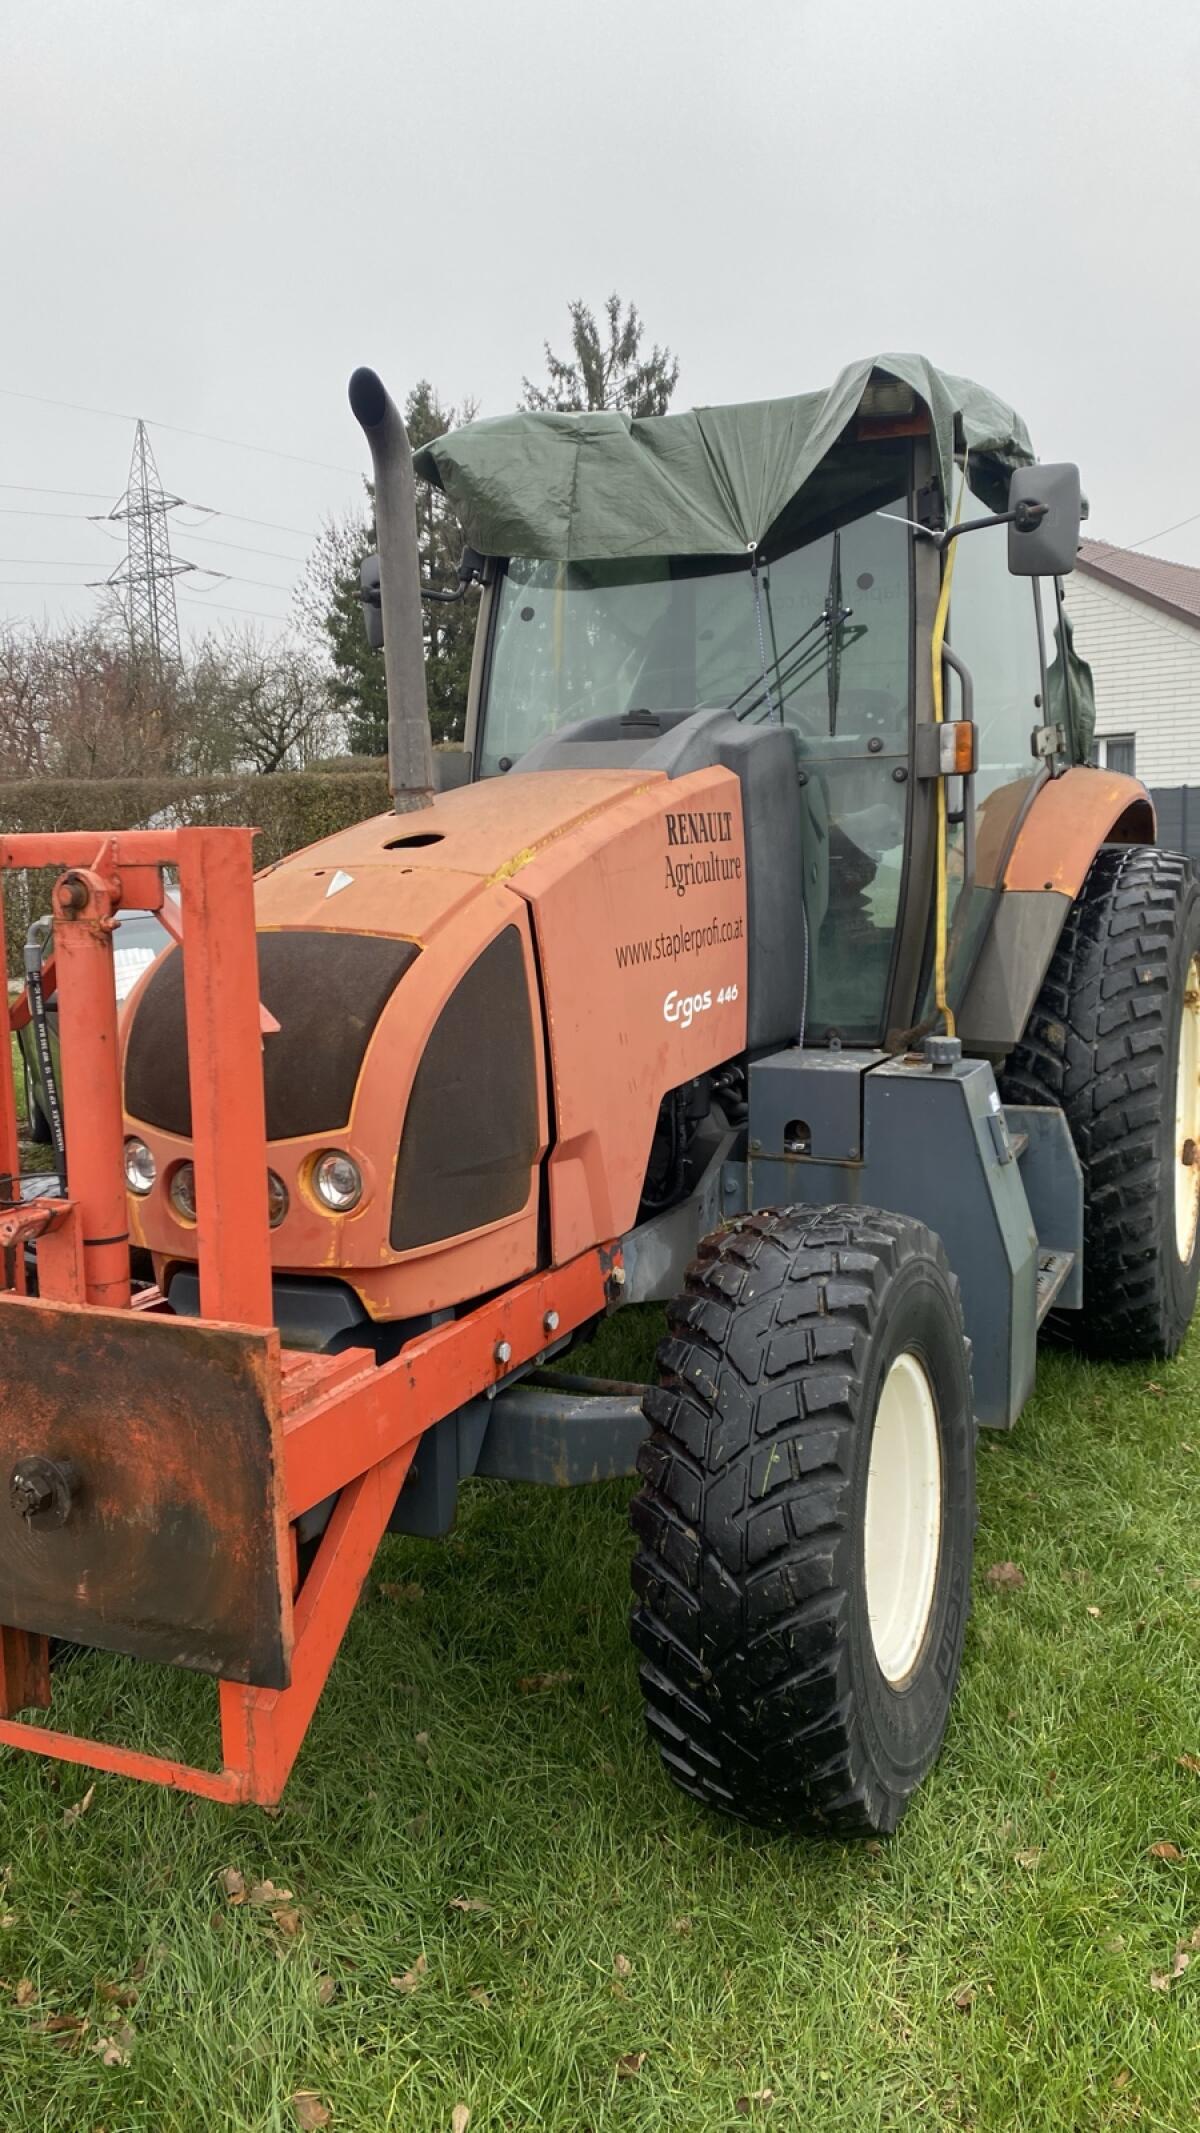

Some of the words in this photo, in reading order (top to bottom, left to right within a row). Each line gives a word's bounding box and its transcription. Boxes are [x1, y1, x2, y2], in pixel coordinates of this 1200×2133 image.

[665, 812, 732, 846] RENAULT
[664, 851, 742, 897] Agriculture
[616, 916, 744, 968] www.staplerprofi.co.at
[663, 990, 712, 1028] Ergos
[717, 984, 739, 1004] 446
